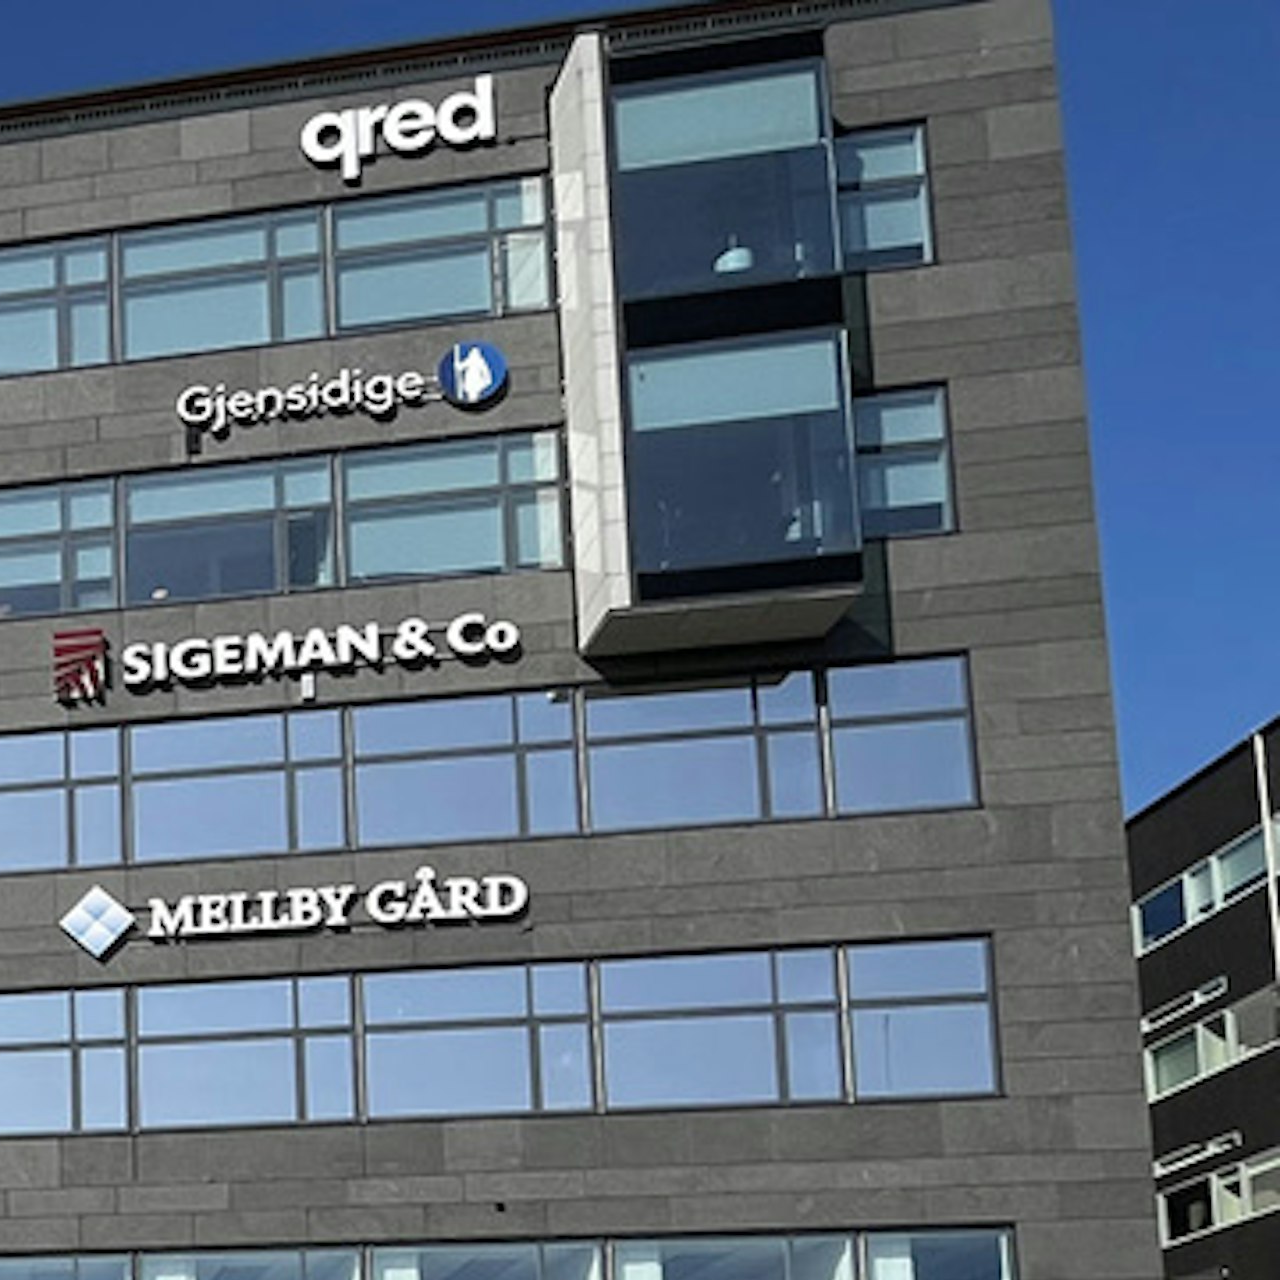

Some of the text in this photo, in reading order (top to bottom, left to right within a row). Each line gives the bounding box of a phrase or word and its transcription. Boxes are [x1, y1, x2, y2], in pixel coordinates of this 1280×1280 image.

[300, 73, 496, 179] qred
[176, 368, 425, 432] Gjensidige
[122, 613, 520, 685] SIGEMAN & Co
[146, 865, 529, 937] MELLBY GÅRD
